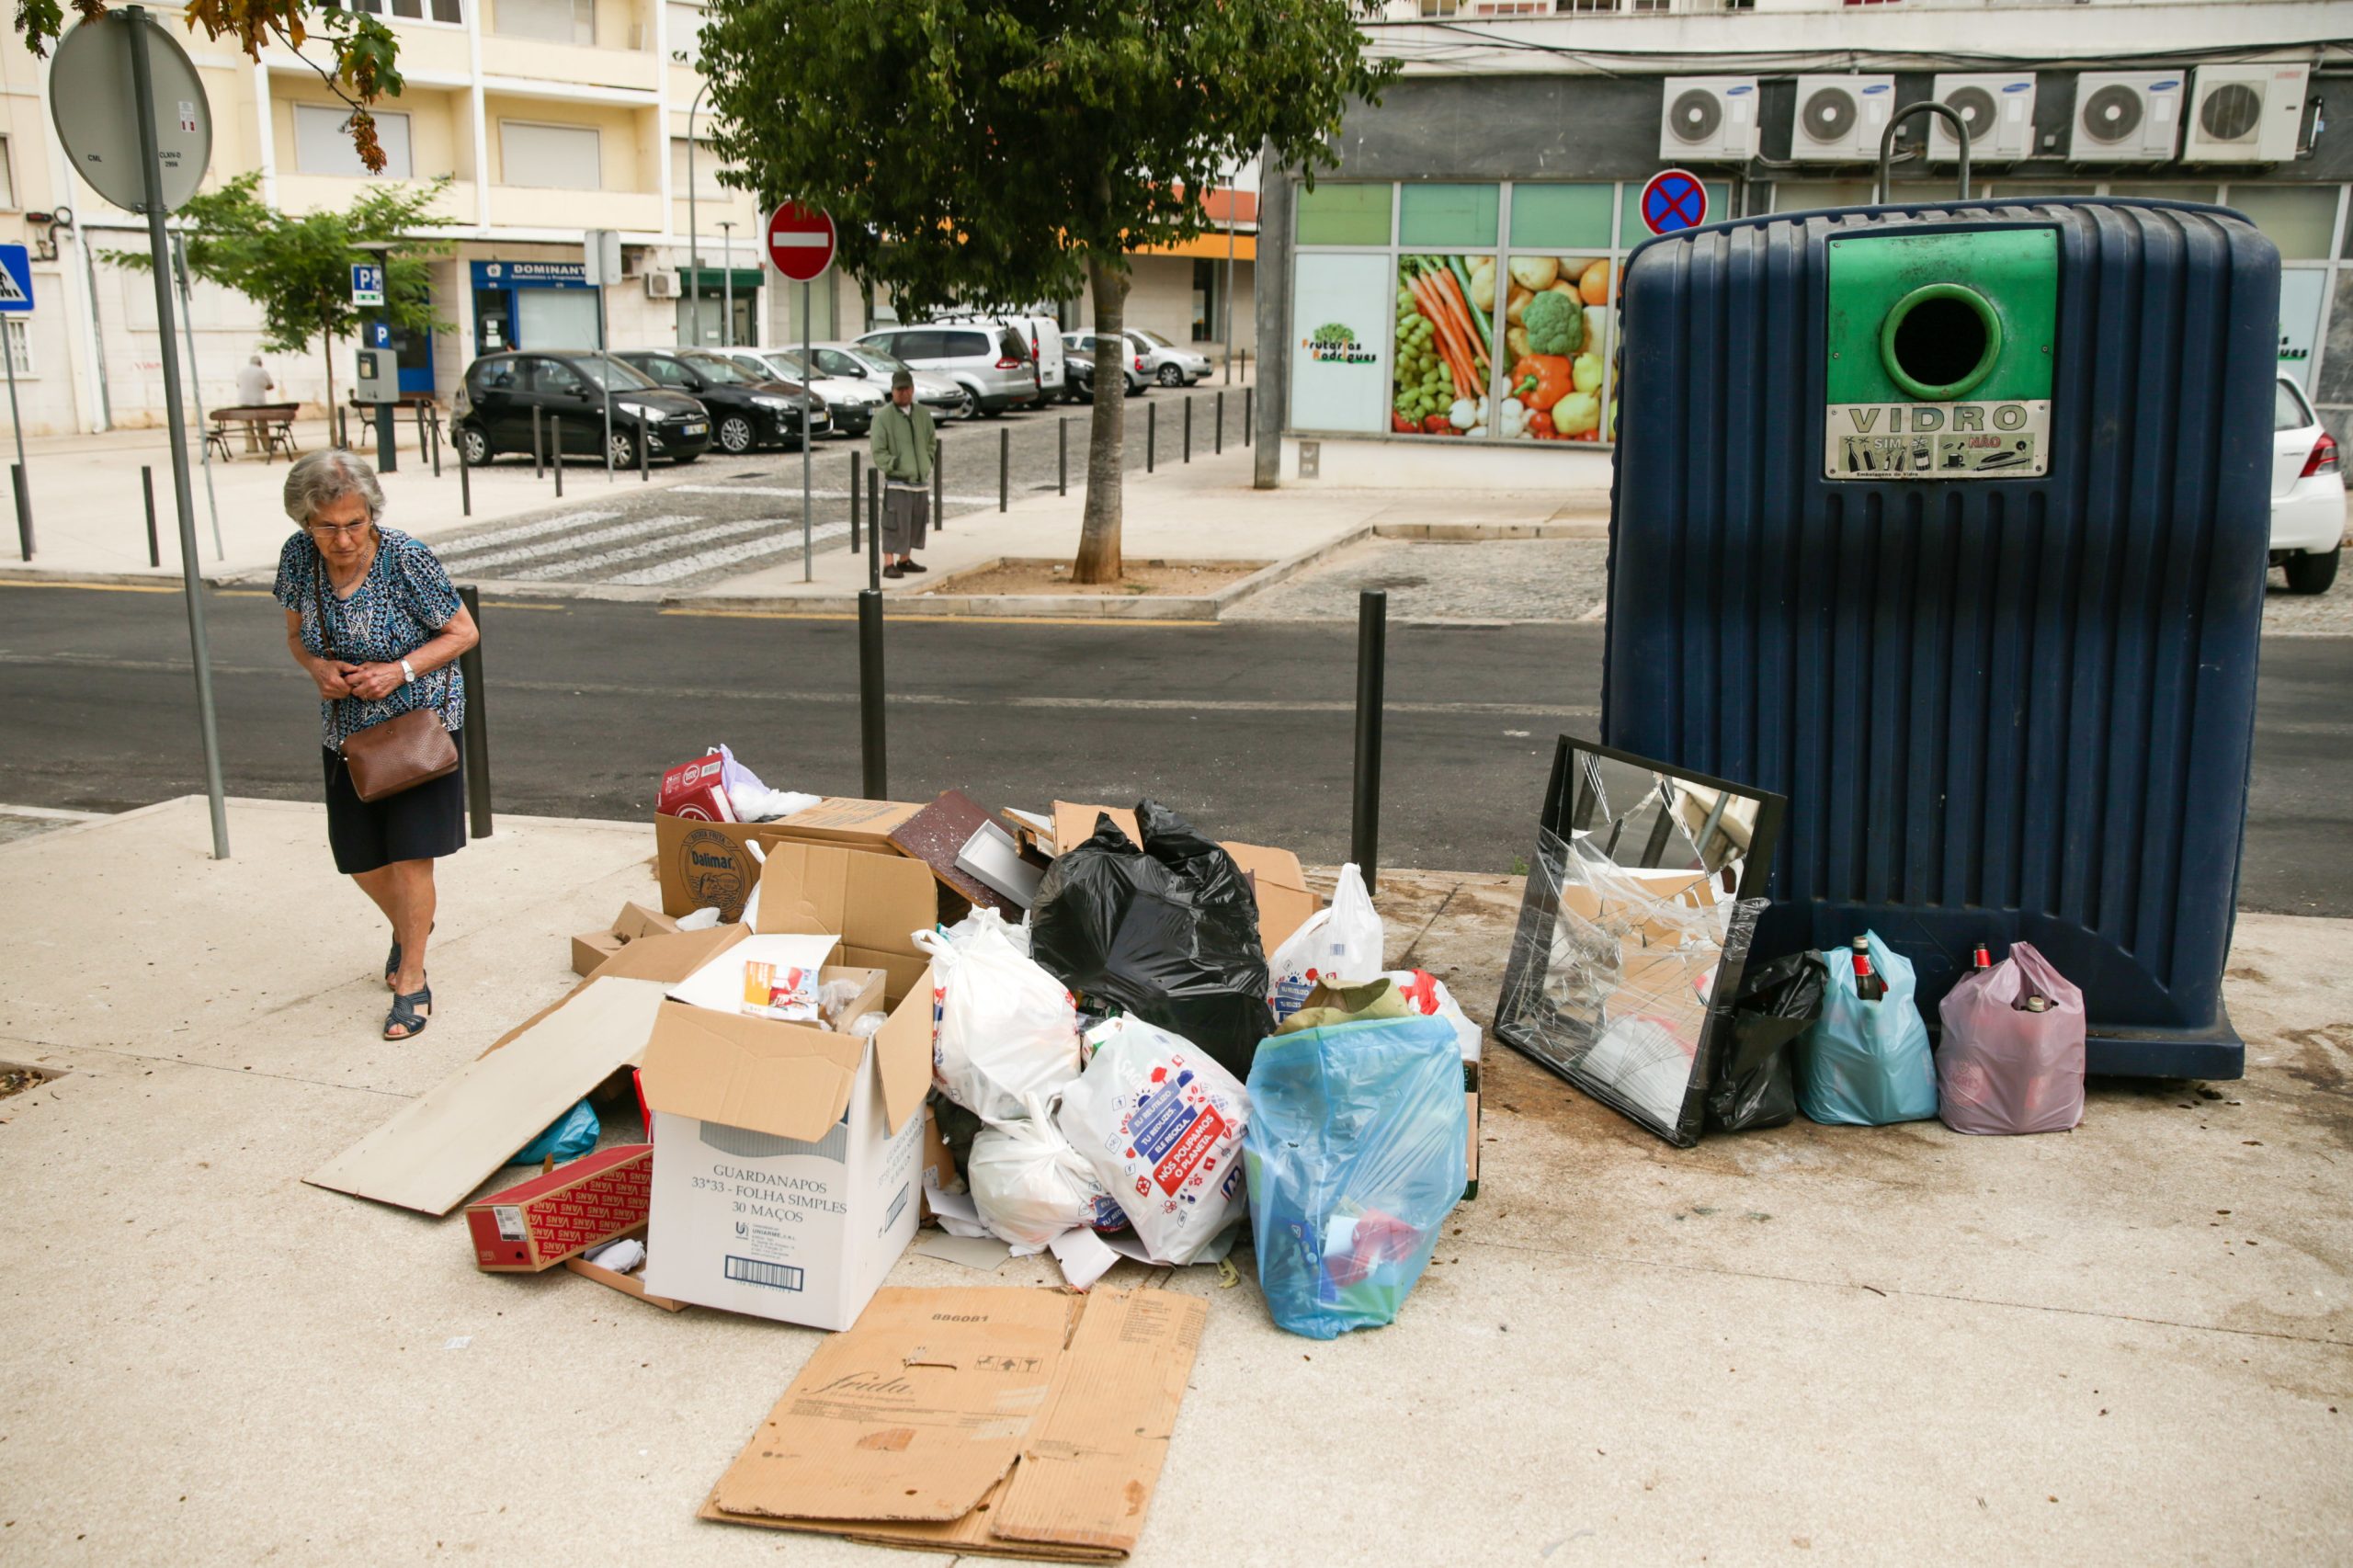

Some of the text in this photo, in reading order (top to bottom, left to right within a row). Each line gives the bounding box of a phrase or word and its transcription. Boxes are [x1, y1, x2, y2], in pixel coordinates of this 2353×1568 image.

[87, 154, 103, 163] CML
[359, 268, 371, 290] P
[377, 325, 388, 344] P
[1847, 404, 2028, 434] VIDRO
[1873, 437, 1902, 450] SIM
[1968, 435, 2002, 449] NÃO
[691, 849, 733, 870] Dalimar
[1133, 1088, 1175, 1129] EU REUTILIZO.
[1141, 1134, 1153, 1146] TU
[1154, 1141, 1168, 1153] ELE
[1158, 1114, 1215, 1182] NÓS POUPAMOS
[1174, 1133, 1214, 1178] O PLANETA.
[713, 1164, 827, 1194] GUARDANAPOS
[590, 1181, 612, 1193] VANS
[616, 1184, 638, 1195] VANS
[575, 1192, 598, 1205] VANS
[602, 1195, 624, 1207] VANS
[735, 1185, 785, 1204] FOLHA
[788, 1194, 847, 1214] SIMPLES
[532, 1201, 635, 1221] VANS VANS VANS VANS
[732, 1201, 804, 1223] 30 MAÇOS
[546, 1216, 569, 1228] VANS
[573, 1219, 596, 1230] VANS
[598, 1221, 620, 1232] VANS
[558, 1230, 581, 1242] VANS
[542, 1243, 566, 1254] VANS
[931, 1313, 989, 1324] 886081
